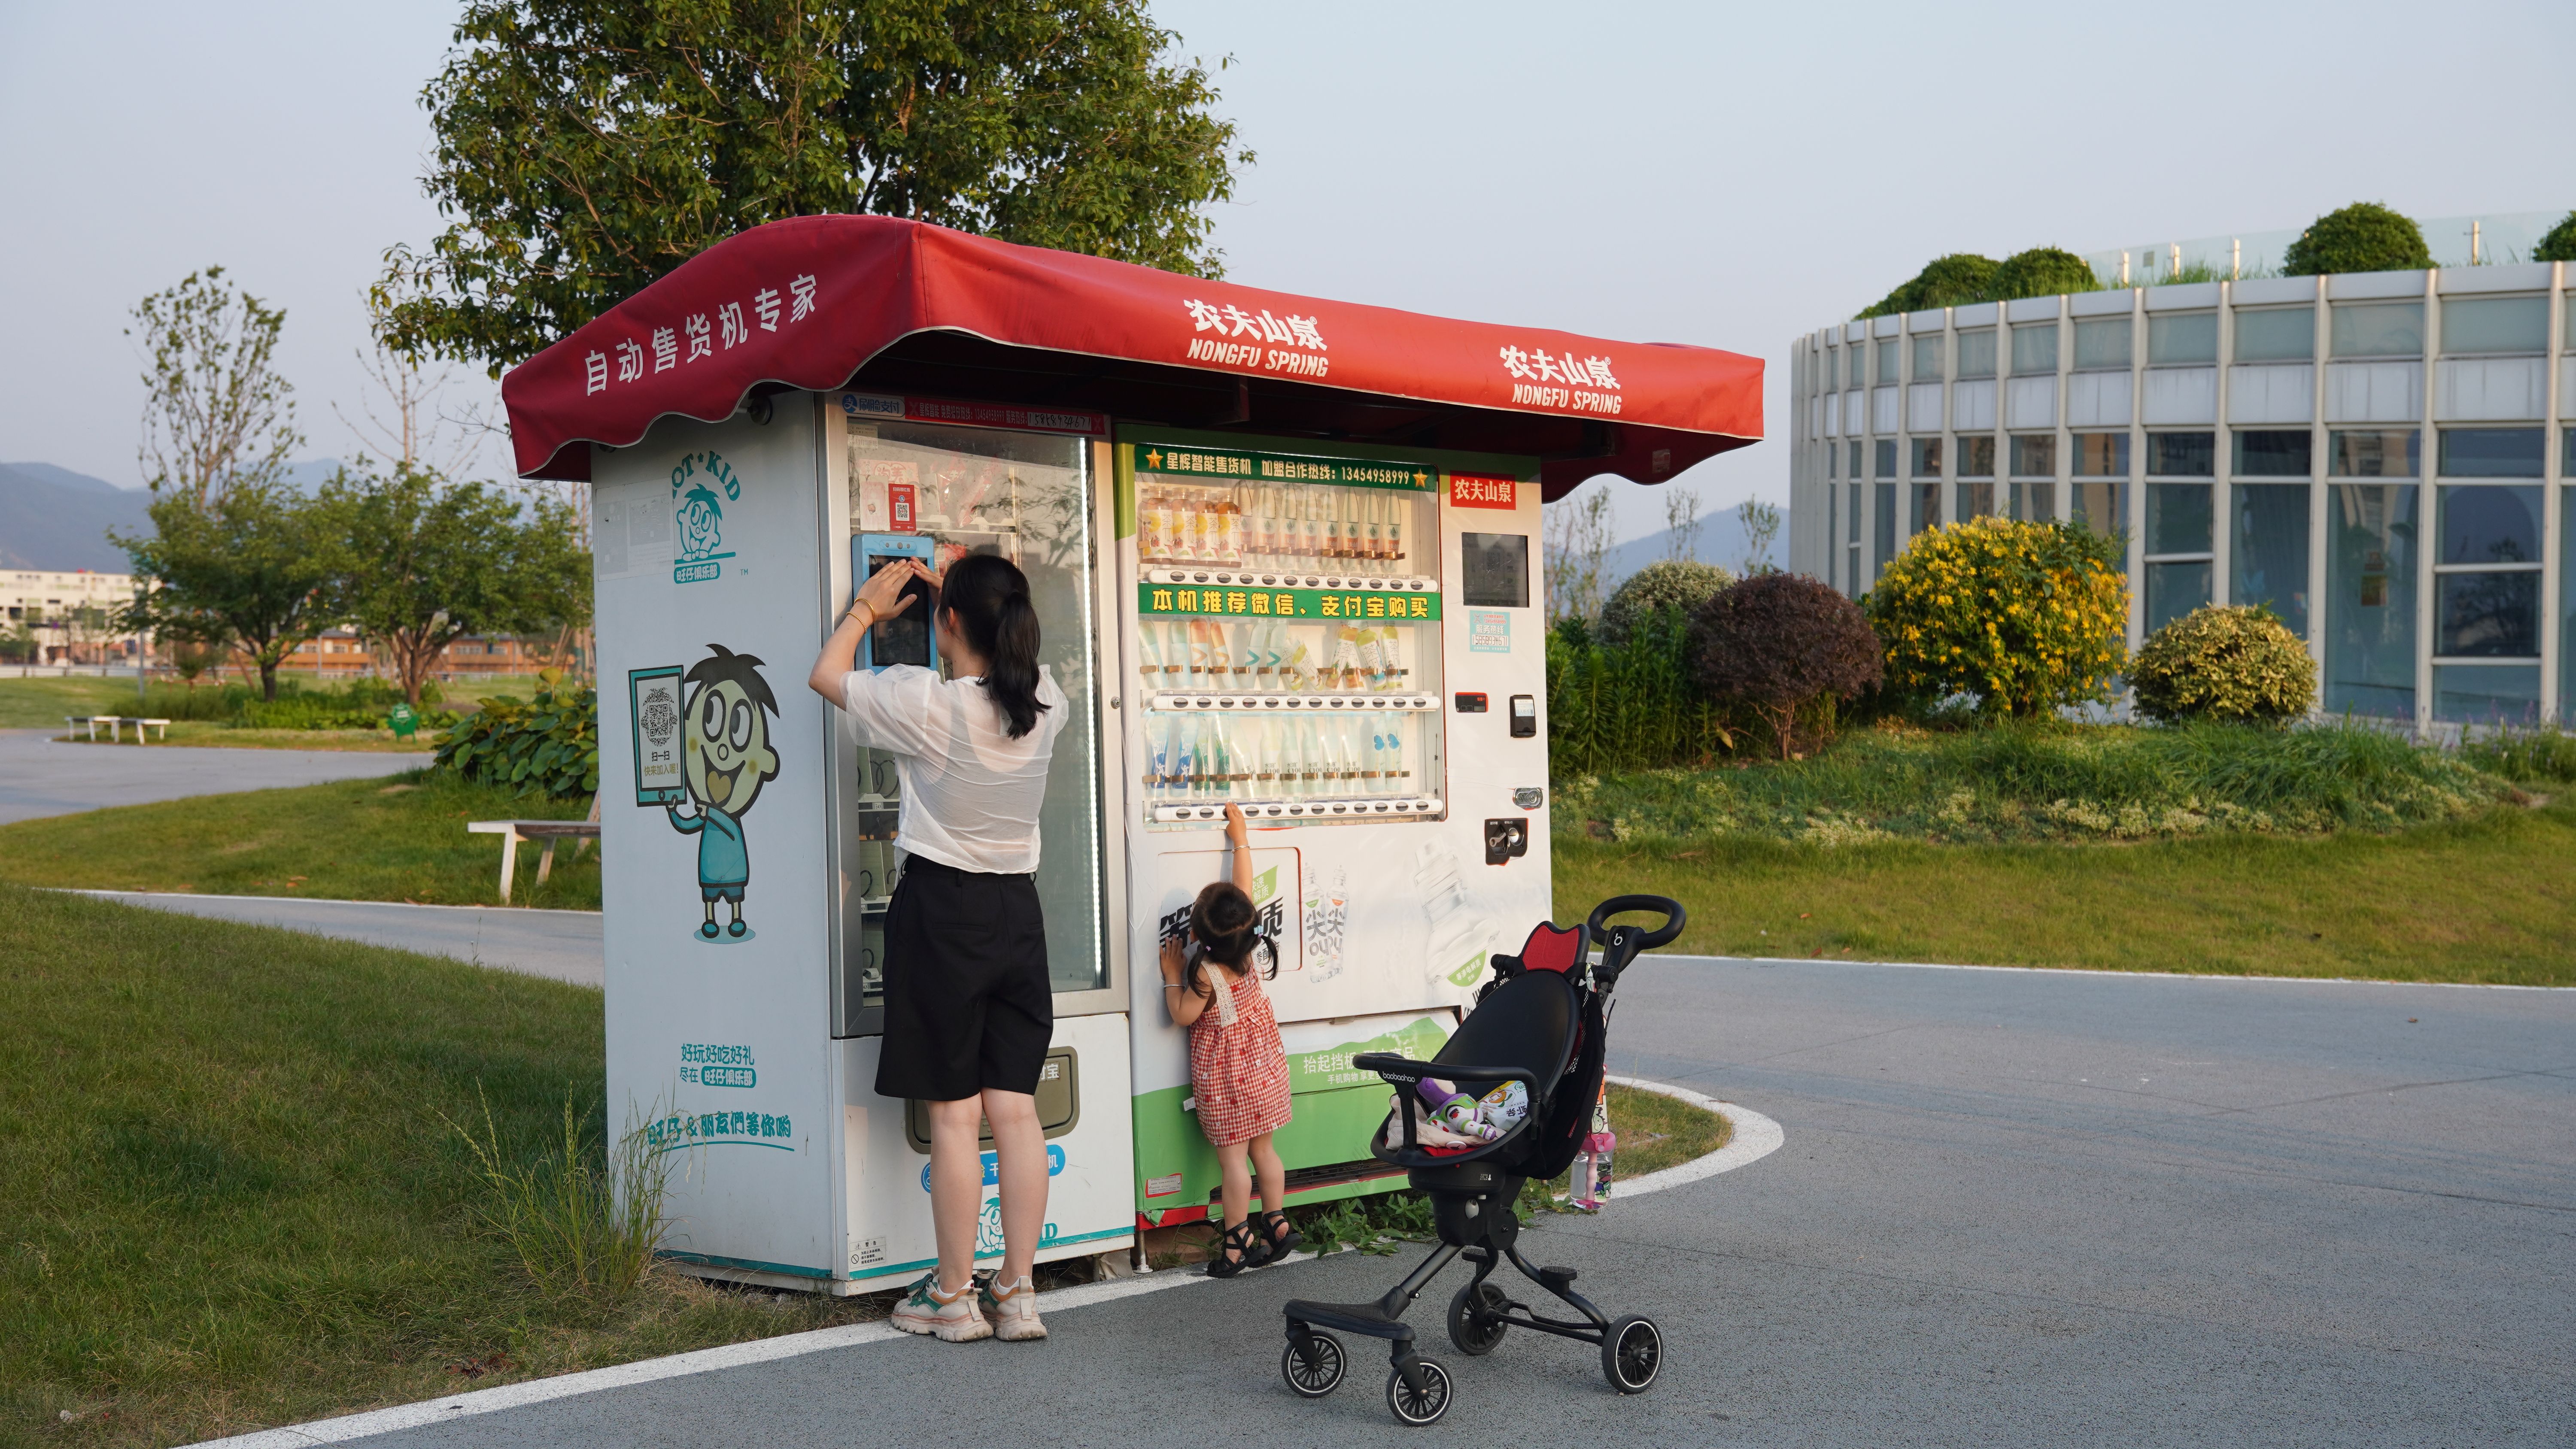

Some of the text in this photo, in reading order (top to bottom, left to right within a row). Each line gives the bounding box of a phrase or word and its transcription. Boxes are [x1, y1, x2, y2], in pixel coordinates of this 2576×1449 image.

[585, 274, 817, 397] 自动售货机专家
[1183, 299, 1328, 352] 农夫山泉
[1187, 338, 1329, 378] NONGFU SPRING
[1499, 345, 1622, 391] 农夫山泉
[860, 398, 900, 414] 刷脸支付
[1511, 383, 1622, 415] NONGFU SPRING
[1167, 452, 1251, 475] 星辉智能售货机
[1342, 467, 1409, 485] 13454958999
[1455, 478, 1512, 503] 农夫山泉
[677, 564, 717, 582] 旺仔俱乐部
[1152, 589, 1428, 618] 本机推荐微信、支付宝购买
[1473, 635, 1507, 646] 15858934671
[1477, 625, 1504, 635] 服务热线
[652, 751, 670, 762] 扫一扫
[681, 1043, 755, 1065] 好玩好吃好礼
[680, 1067, 753, 1086] 尽在 旺仔俱乐部
[1327, 1072, 1358, 1085] 手机购物
[1382, 1071, 1415, 1082] baobaohao
